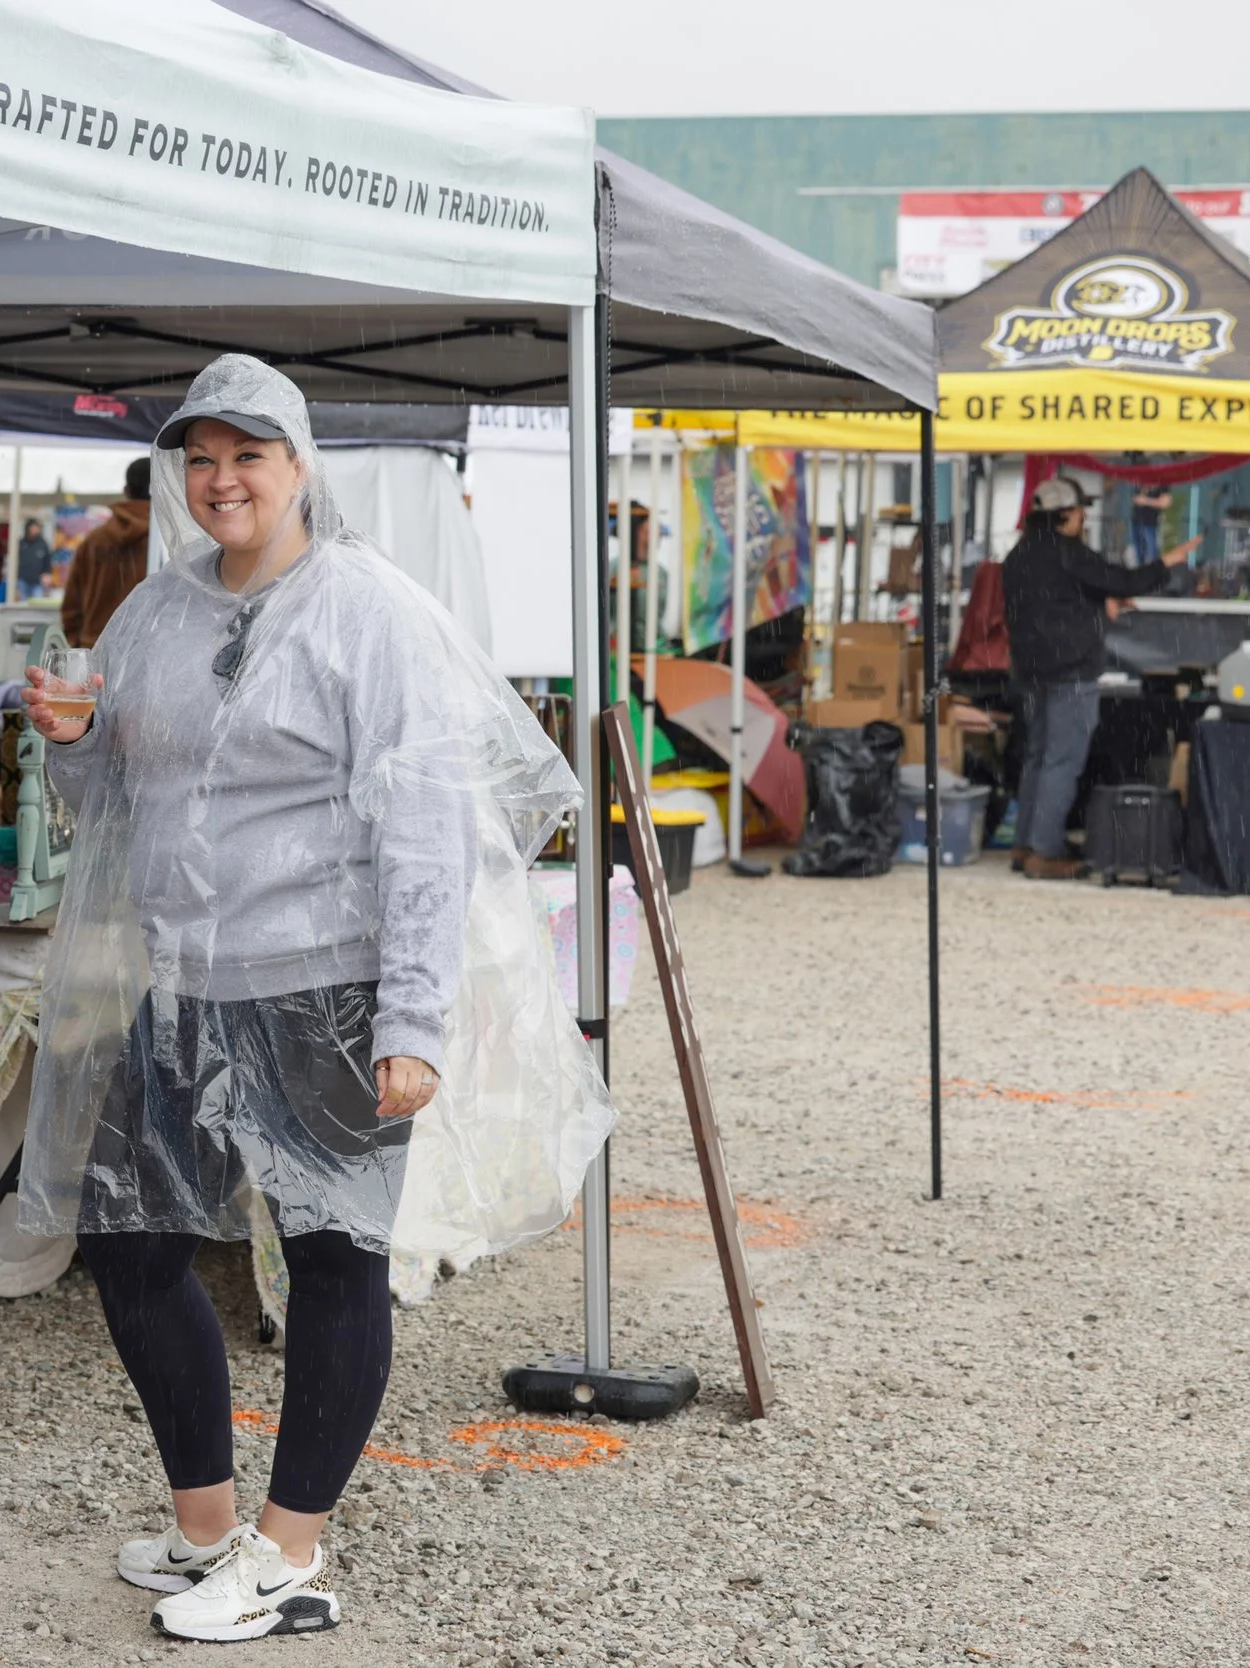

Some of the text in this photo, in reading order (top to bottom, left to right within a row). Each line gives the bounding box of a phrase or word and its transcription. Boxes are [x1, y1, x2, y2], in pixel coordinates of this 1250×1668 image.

[128, 117, 189, 167] FOR
[200, 132, 293, 189] TODAY.
[304, 156, 398, 209] ROOTED
[404, 179, 429, 216] IN
[438, 185, 550, 233] TRADITION.
[1006, 316, 1212, 350] MOON DROPS
[965, 395, 1006, 421] OF
[1019, 395, 1160, 422] SHARED
[1177, 396, 1249, 423] EXP
